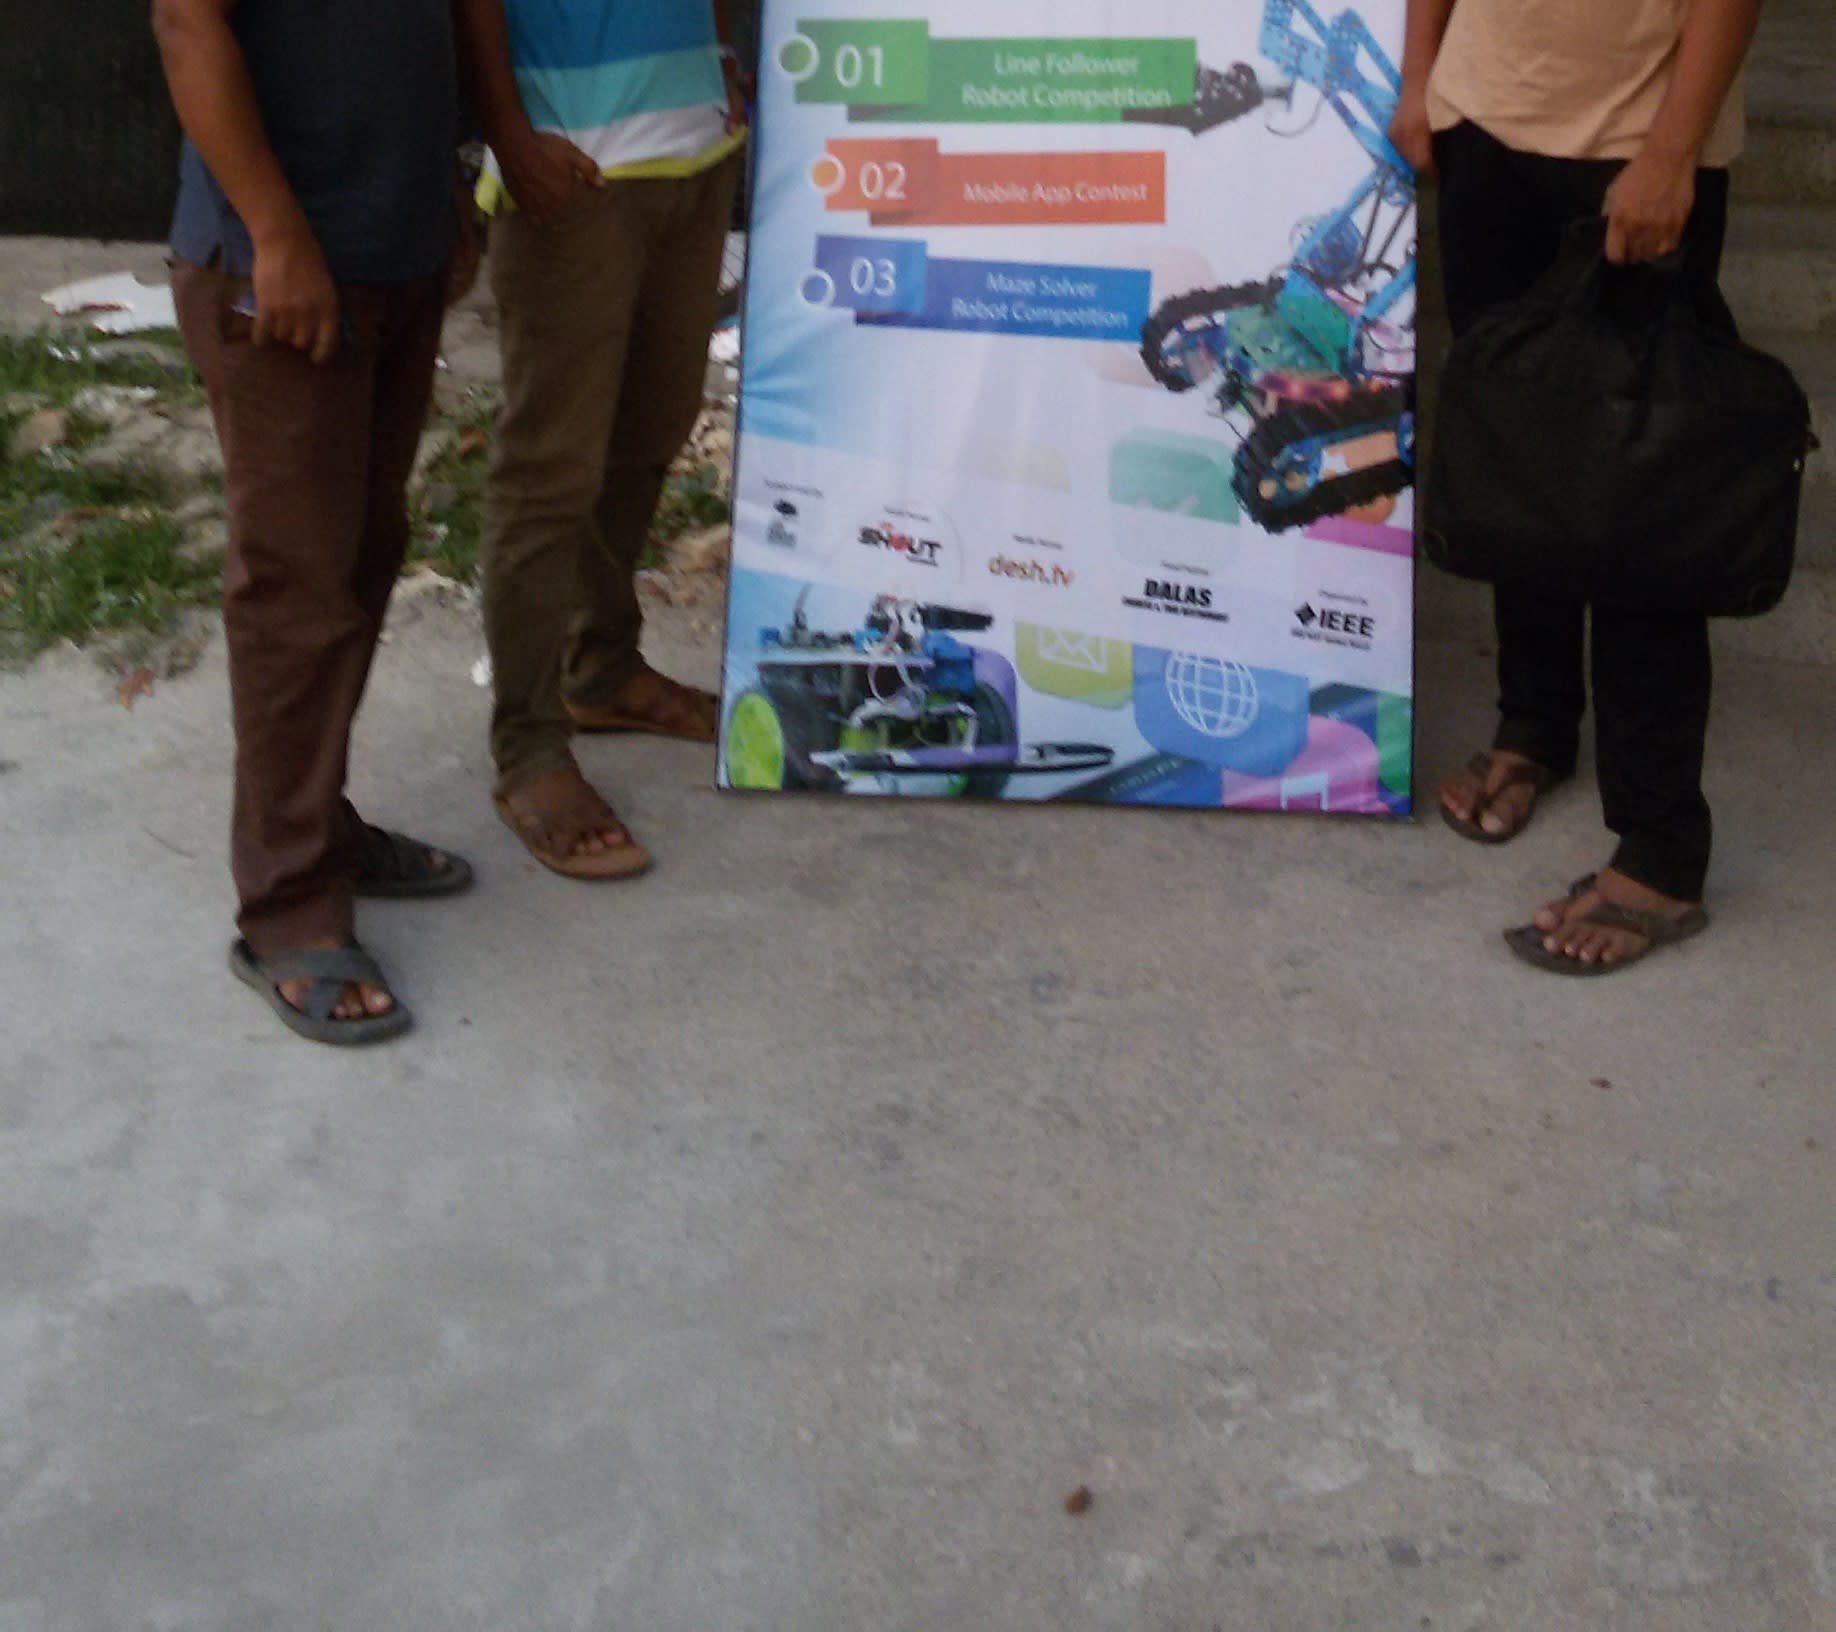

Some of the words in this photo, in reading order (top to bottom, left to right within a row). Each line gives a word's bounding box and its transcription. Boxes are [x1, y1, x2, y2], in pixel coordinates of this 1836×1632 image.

[834, 43, 885, 89] 01
[994, 52, 1042, 74] Line
[1046, 52, 1140, 75] Follower
[961, 84, 1028, 107] Robot
[1033, 84, 1173, 109] Competition
[859, 161, 907, 201] 02
[963, 182, 1028, 203] Mobile
[1031, 183, 1071, 205] App
[1075, 182, 1148, 202] Contest
[850, 257, 897, 297] 03
[986, 273, 1037, 295] Maze
[1039, 275, 1097, 298] Solver
[952, 298, 1008, 321] Robot
[1011, 300, 1129, 329] Competition
[1144, 578, 1213, 607] DALAS
[1319, 607, 1376, 639] IEEE
